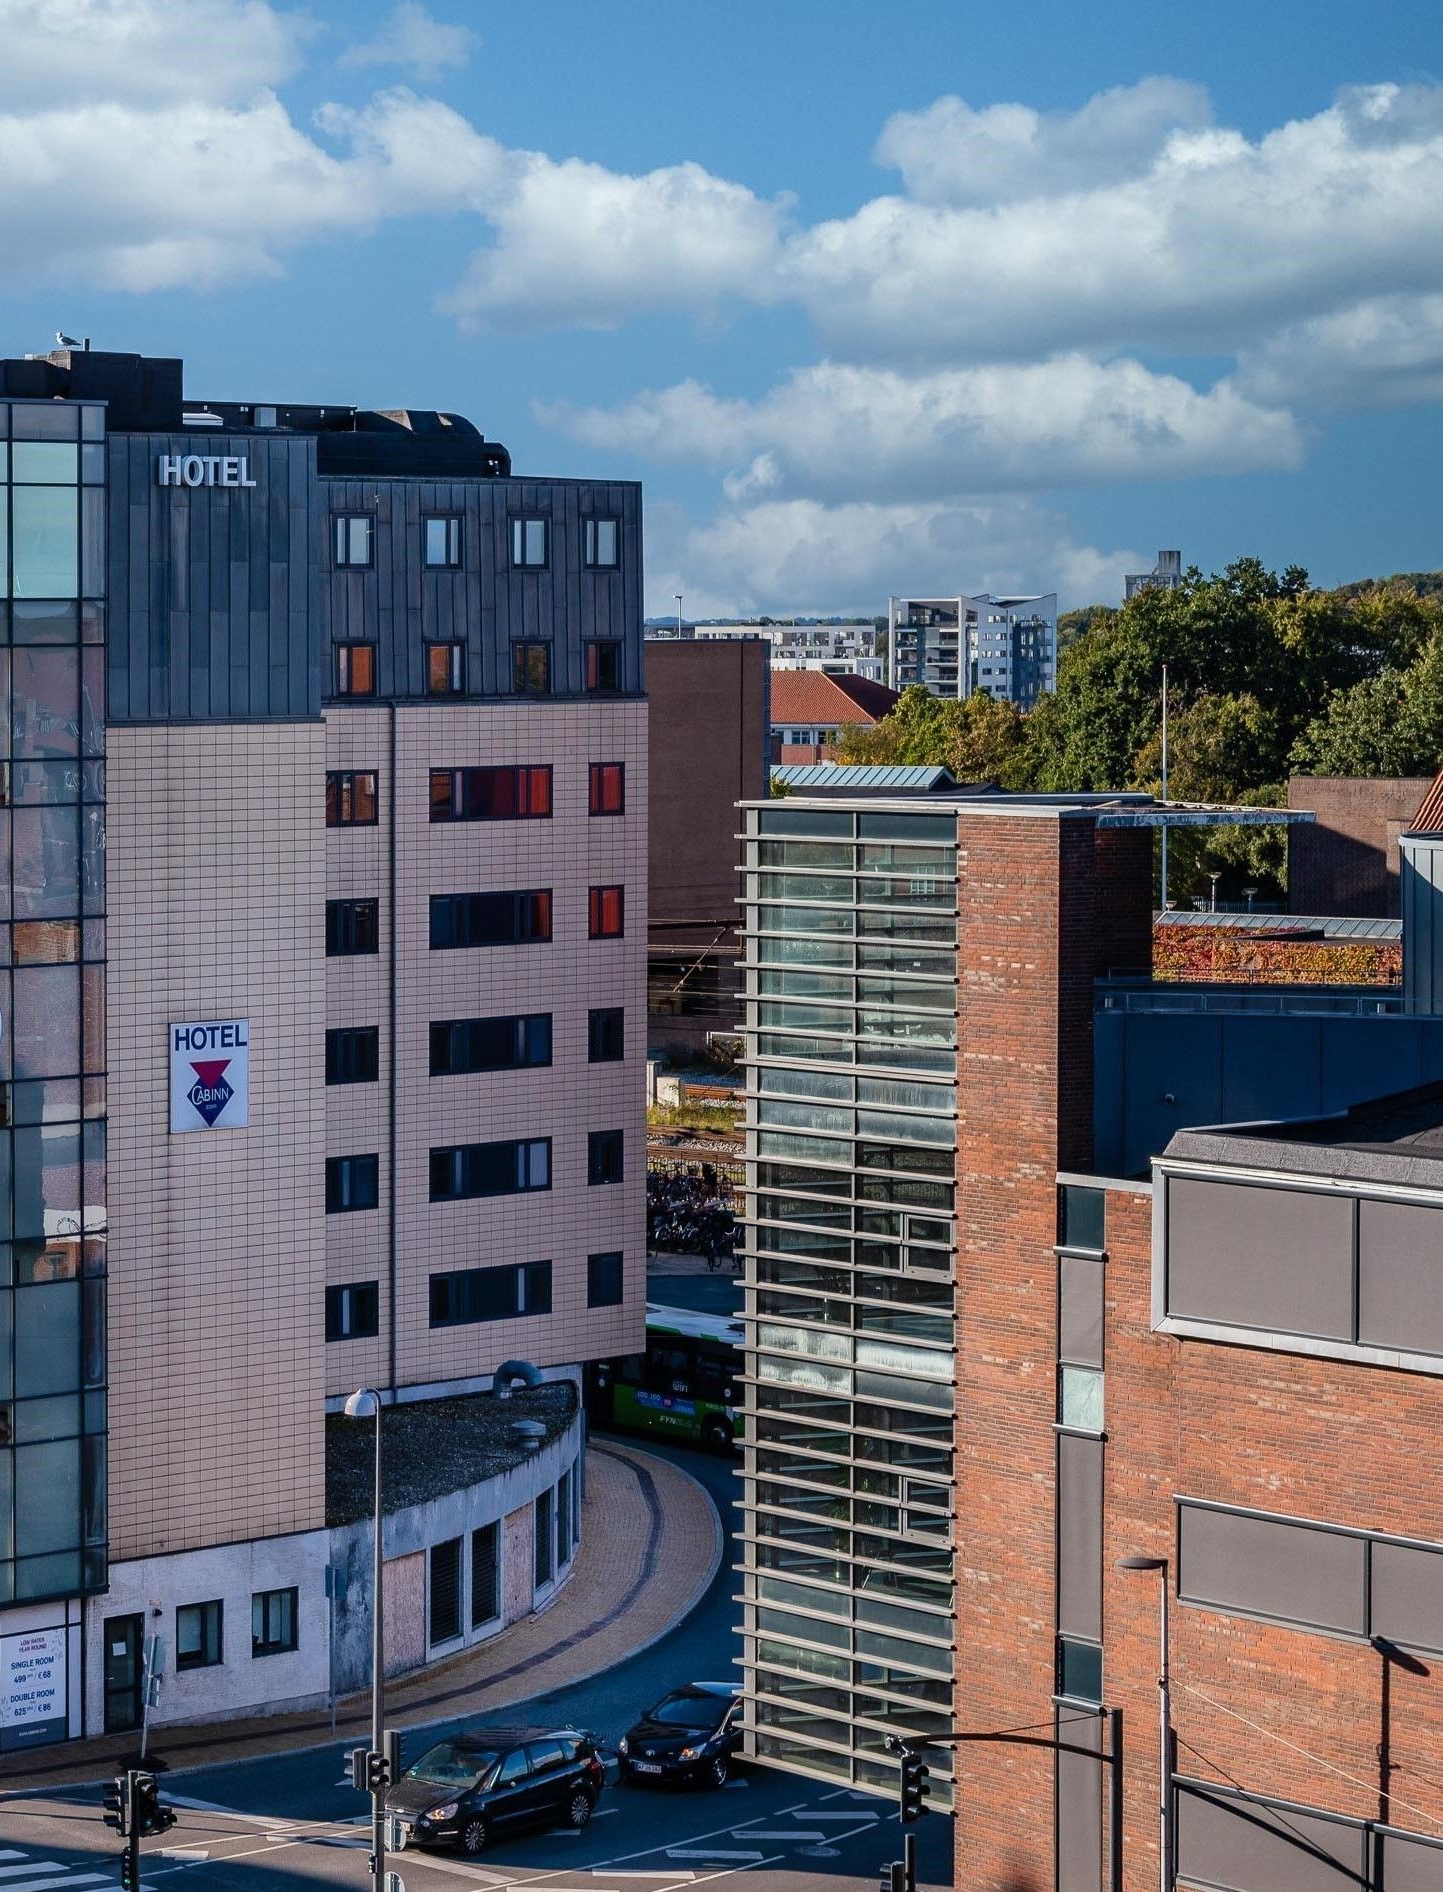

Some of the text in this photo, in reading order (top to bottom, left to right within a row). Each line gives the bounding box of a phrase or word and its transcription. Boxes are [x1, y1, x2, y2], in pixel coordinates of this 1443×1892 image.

[159, 455, 257, 487] HOTEL
[175, 1024, 248, 1051] HOTEL
[191, 1085, 229, 1105] CABINN
[11, 1655, 54, 1670] SINGLE ROOM
[14, 1674, 26, 1683] 499
[11, 1688, 55, 1703] DOUBLE ROOM
[14, 1707, 27, 1717] 625
